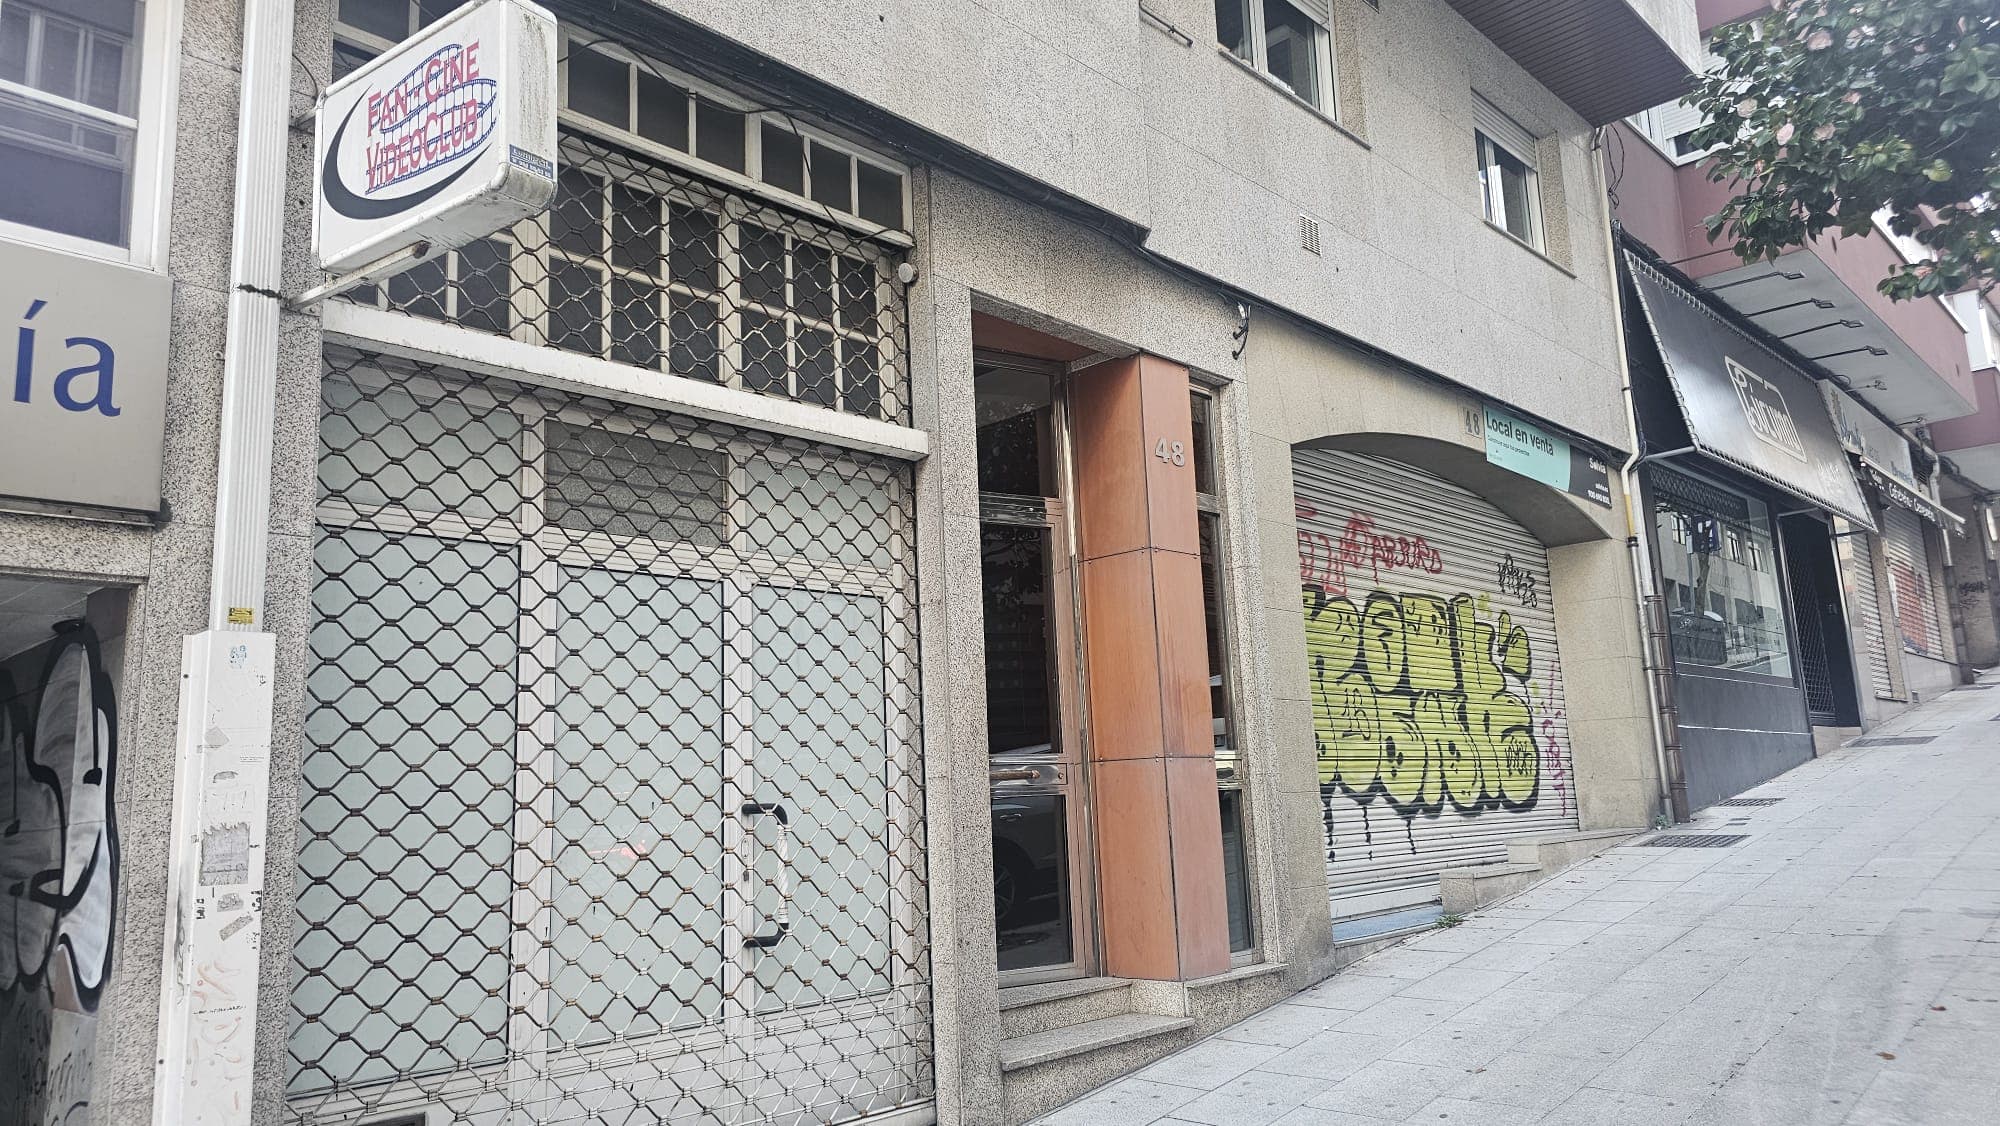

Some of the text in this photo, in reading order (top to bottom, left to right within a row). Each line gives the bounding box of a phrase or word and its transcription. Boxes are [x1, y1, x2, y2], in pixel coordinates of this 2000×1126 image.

[1465, 410, 1480, 435] 48
[1486, 411, 1513, 438] Local
[1515, 428, 1528, 444] en
[1530, 433, 1554, 456] venta
[1155, 437, 1185, 467] 48
